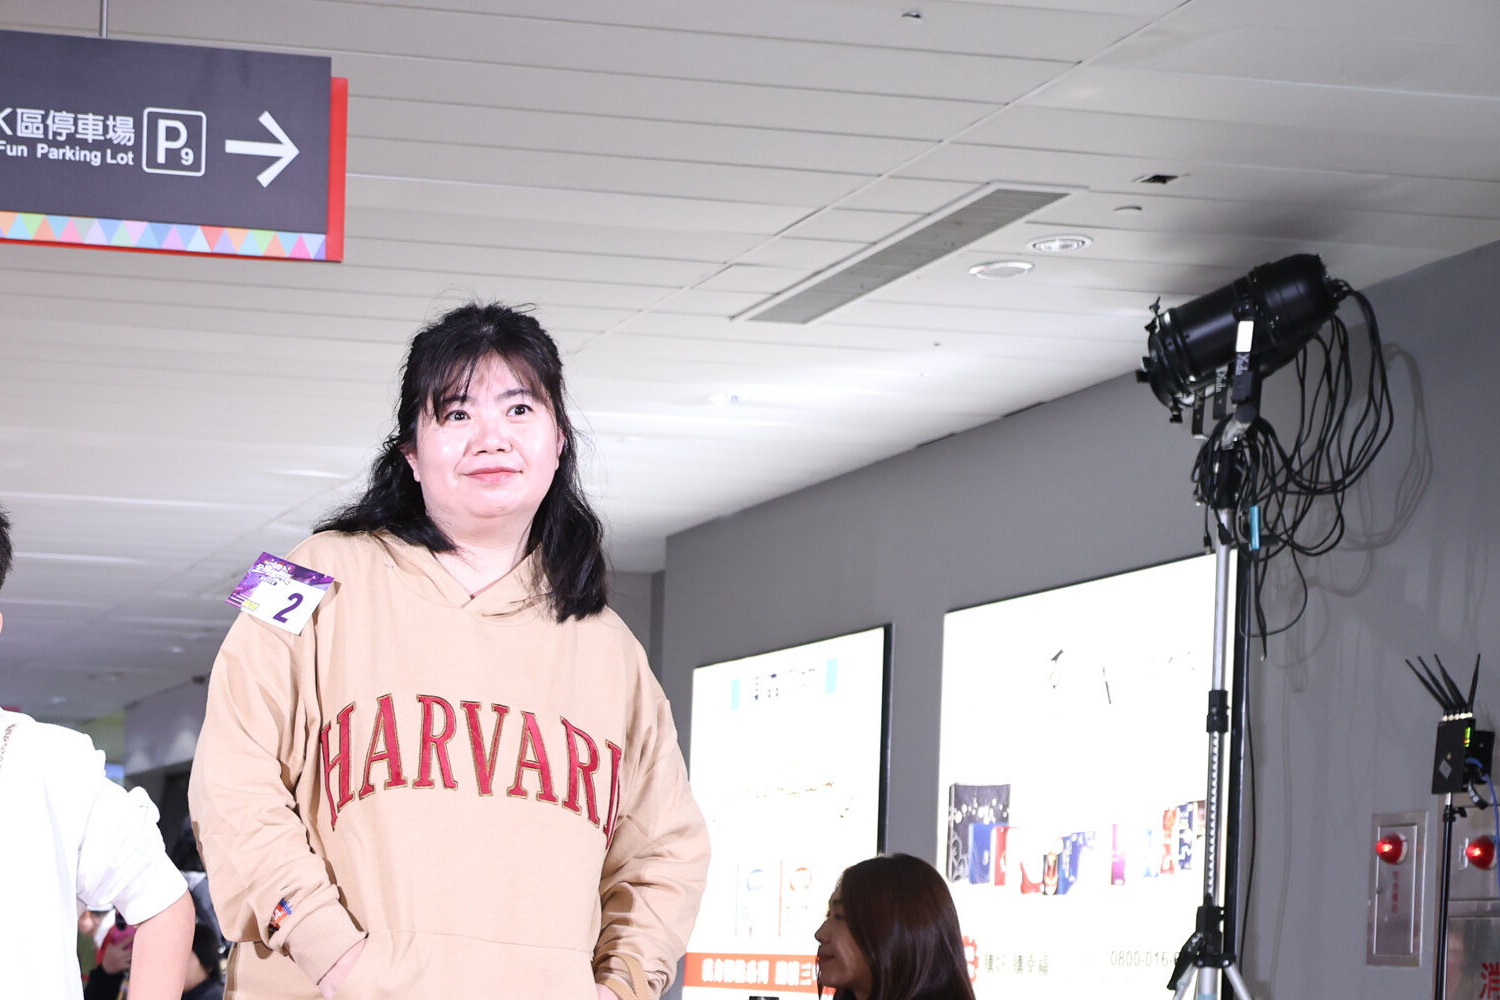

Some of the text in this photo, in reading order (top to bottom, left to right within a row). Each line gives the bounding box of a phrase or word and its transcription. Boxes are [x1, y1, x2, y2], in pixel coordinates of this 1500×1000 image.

[36, 143, 101, 166] Parking
[106, 148, 134, 165] Lot
[273, 593, 303, 623] 2
